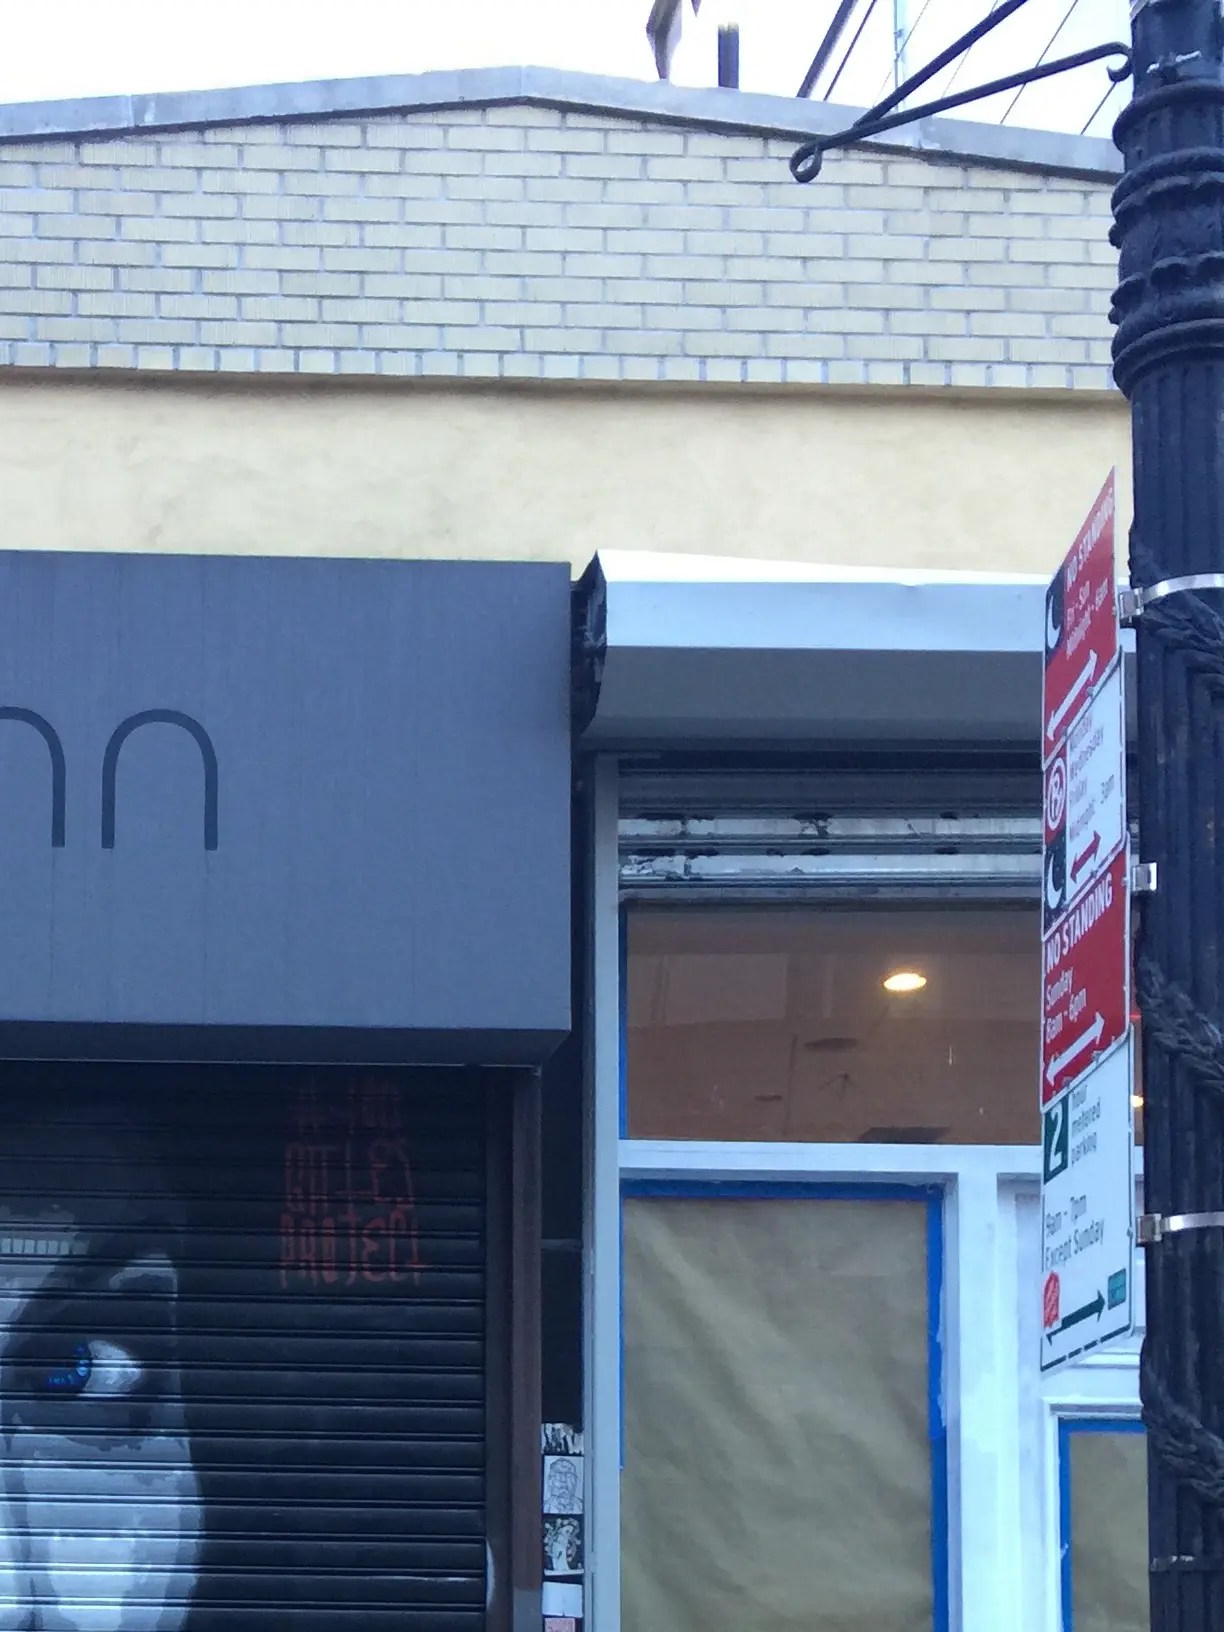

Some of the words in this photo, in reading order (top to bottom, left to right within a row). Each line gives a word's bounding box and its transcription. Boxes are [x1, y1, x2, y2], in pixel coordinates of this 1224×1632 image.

[1046, 931, 1060, 973] NO
[1062, 872, 1113, 956] STANDING
[1046, 966, 1073, 1011] Sunday
[1049, 1100, 1063, 1172] 2
[1071, 1096, 1101, 1138] metered
[1071, 1131, 1097, 1168] parking
[1046, 1236, 1071, 1271] Except
[1073, 1217, 1104, 1255] Sunday
